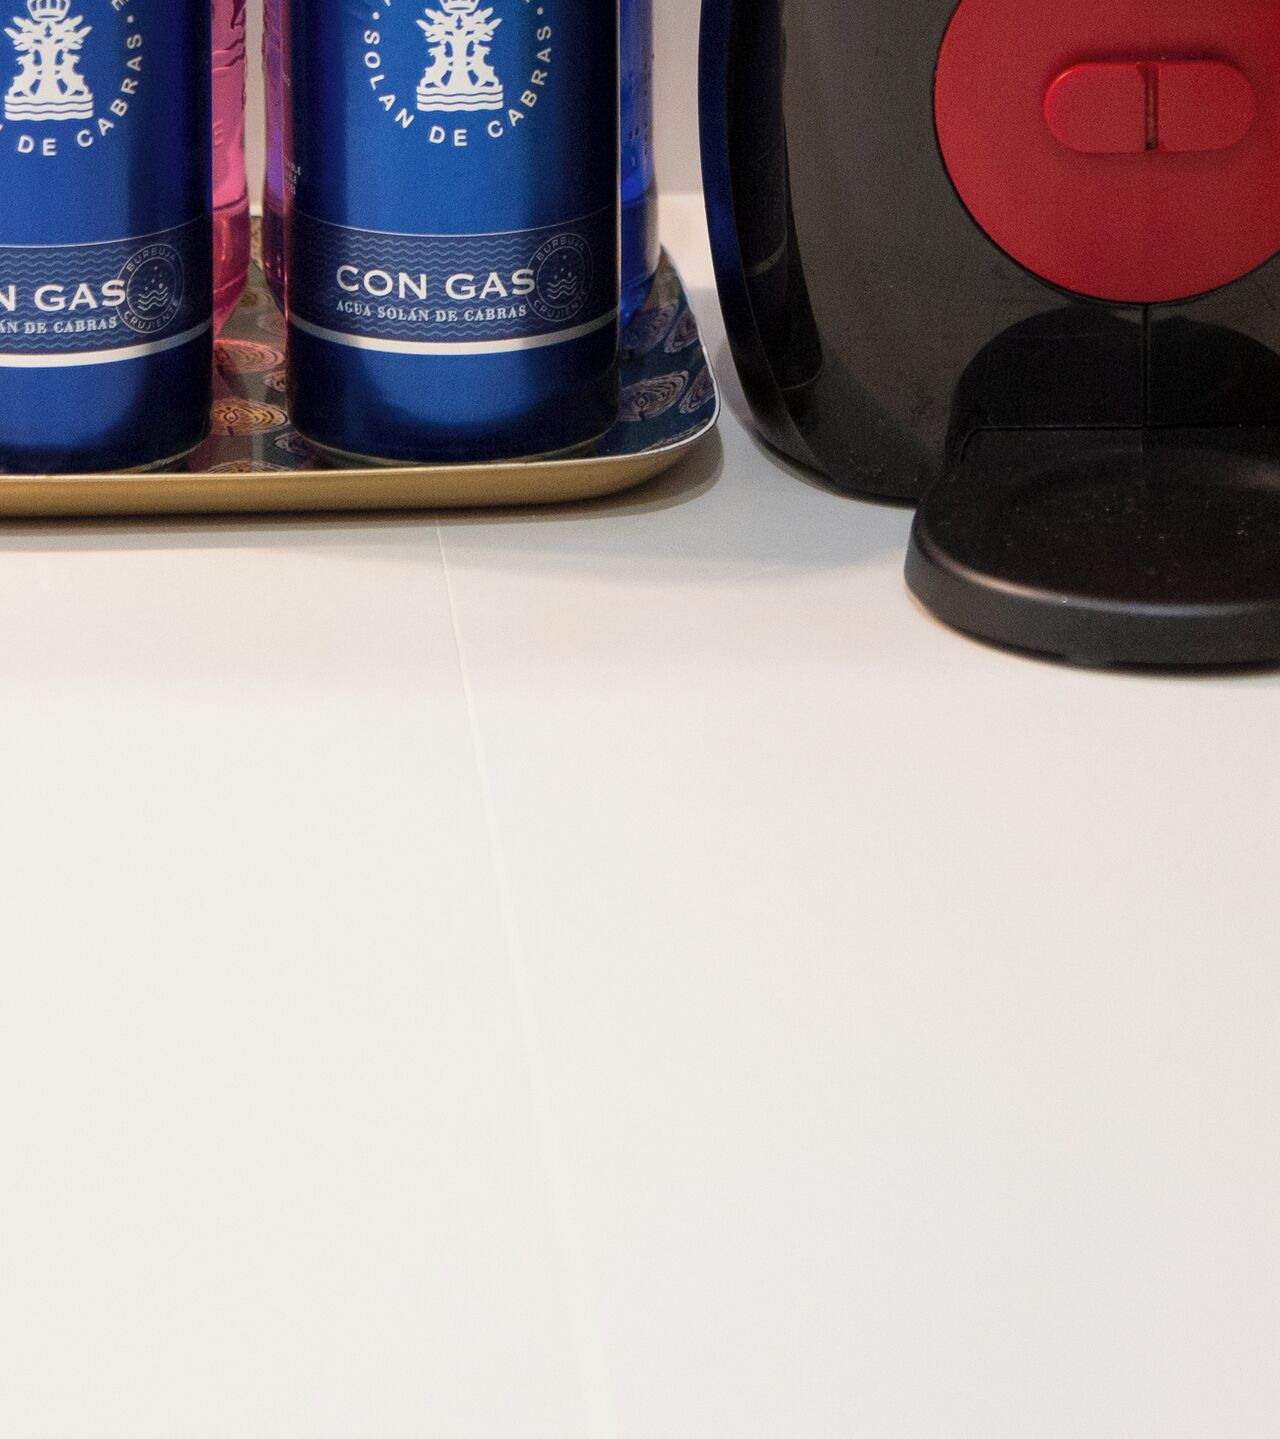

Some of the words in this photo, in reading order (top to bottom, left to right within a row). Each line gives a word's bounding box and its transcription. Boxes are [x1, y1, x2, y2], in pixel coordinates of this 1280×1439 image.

[17, 134, 58, 156] DE
[76, 33, 143, 148] CABRAS
[364, 30, 415, 129] SOLAN
[429, 125, 468, 147] DE
[487, 25, 552, 138] CABRAS
[33, 278, 127, 312] GAS
[335, 264, 428, 301] CON
[444, 267, 536, 301] GAS
[23, 321, 48, 335] DE
[53, 315, 119, 334] CABRAS
[336, 300, 372, 317] AGUA
[377, 305, 430, 322] SOLÁN
[435, 309, 458, 323] DE
[464, 303, 527, 322] CABRAS
